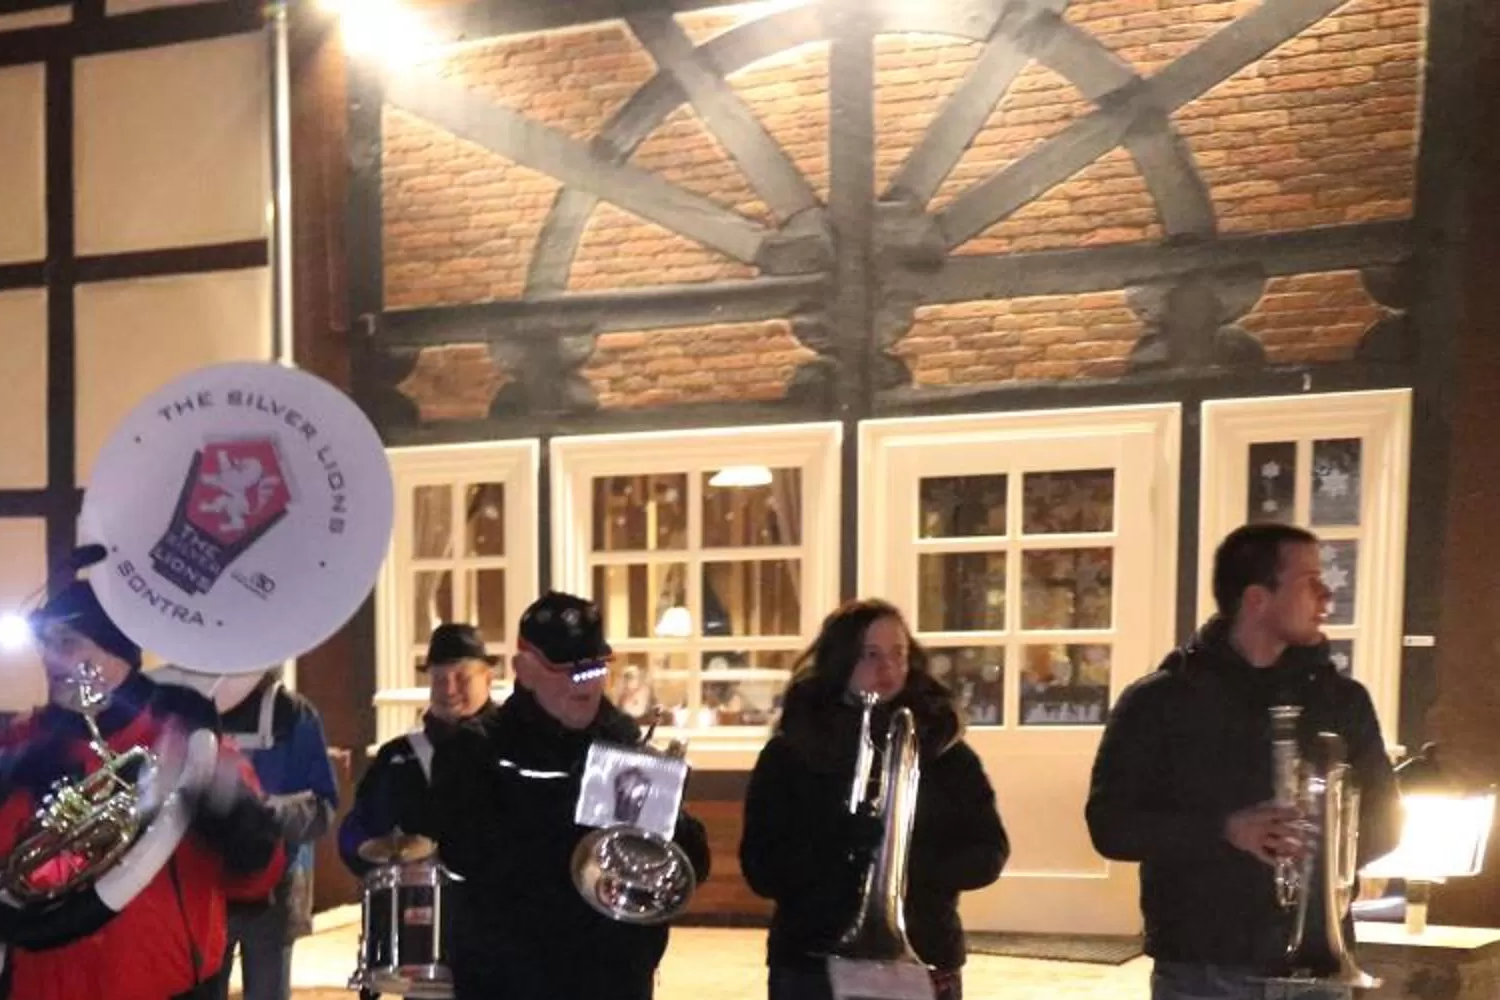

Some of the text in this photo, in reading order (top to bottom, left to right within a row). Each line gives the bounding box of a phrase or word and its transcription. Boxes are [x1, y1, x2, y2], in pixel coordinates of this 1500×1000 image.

[157, 389, 348, 535] THE SILVER LIONS
[116, 559, 206, 627] SONTRA
